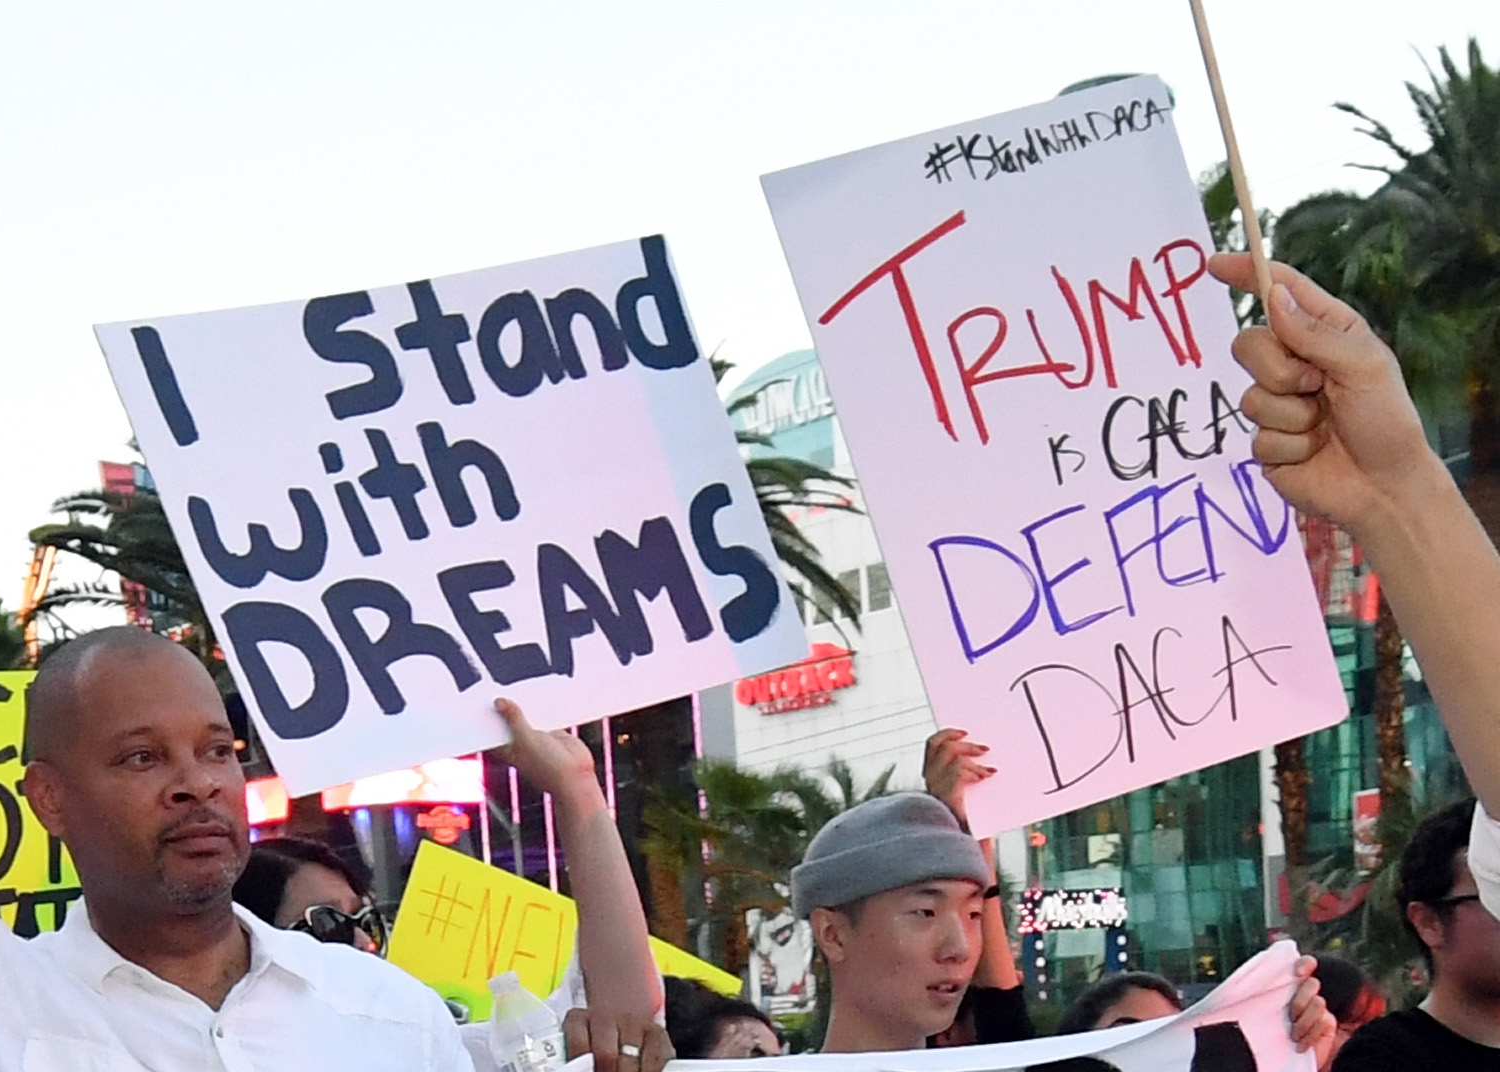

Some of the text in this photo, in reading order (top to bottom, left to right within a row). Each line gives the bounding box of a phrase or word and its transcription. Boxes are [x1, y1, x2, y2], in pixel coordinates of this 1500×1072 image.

[130, 326, 198, 446] I
[302, 234, 699, 420] Stand
[819, 210, 1208, 445] TRUMP
[1102, 380, 1252, 481] CACA
[187, 421, 521, 588] with
[928, 458, 1290, 665] DEFEND
[220, 482, 780, 740] DREAMS
[1010, 615, 1294, 796] DACA
